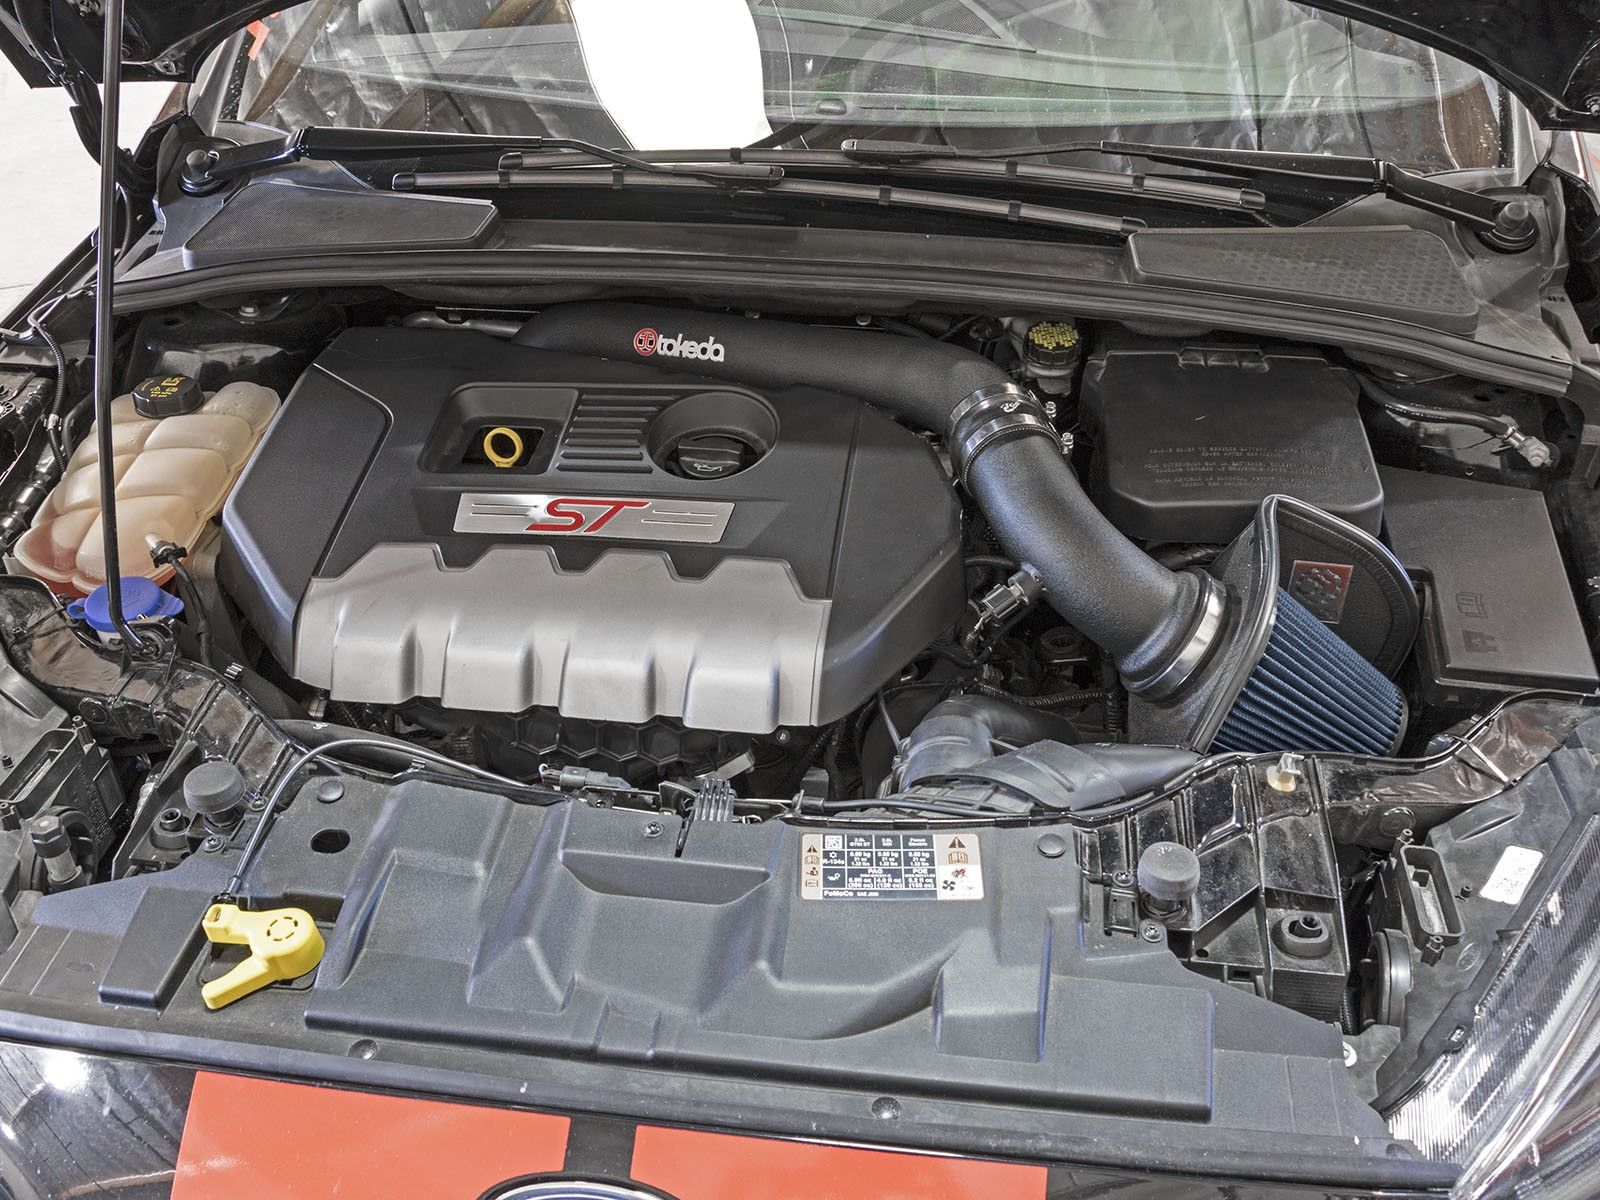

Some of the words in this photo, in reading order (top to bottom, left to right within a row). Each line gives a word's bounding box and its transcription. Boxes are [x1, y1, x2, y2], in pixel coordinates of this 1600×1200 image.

[657, 333, 725, 362] takeda
[523, 497, 653, 534] ST
[823, 889, 854, 897] FoMoCo
